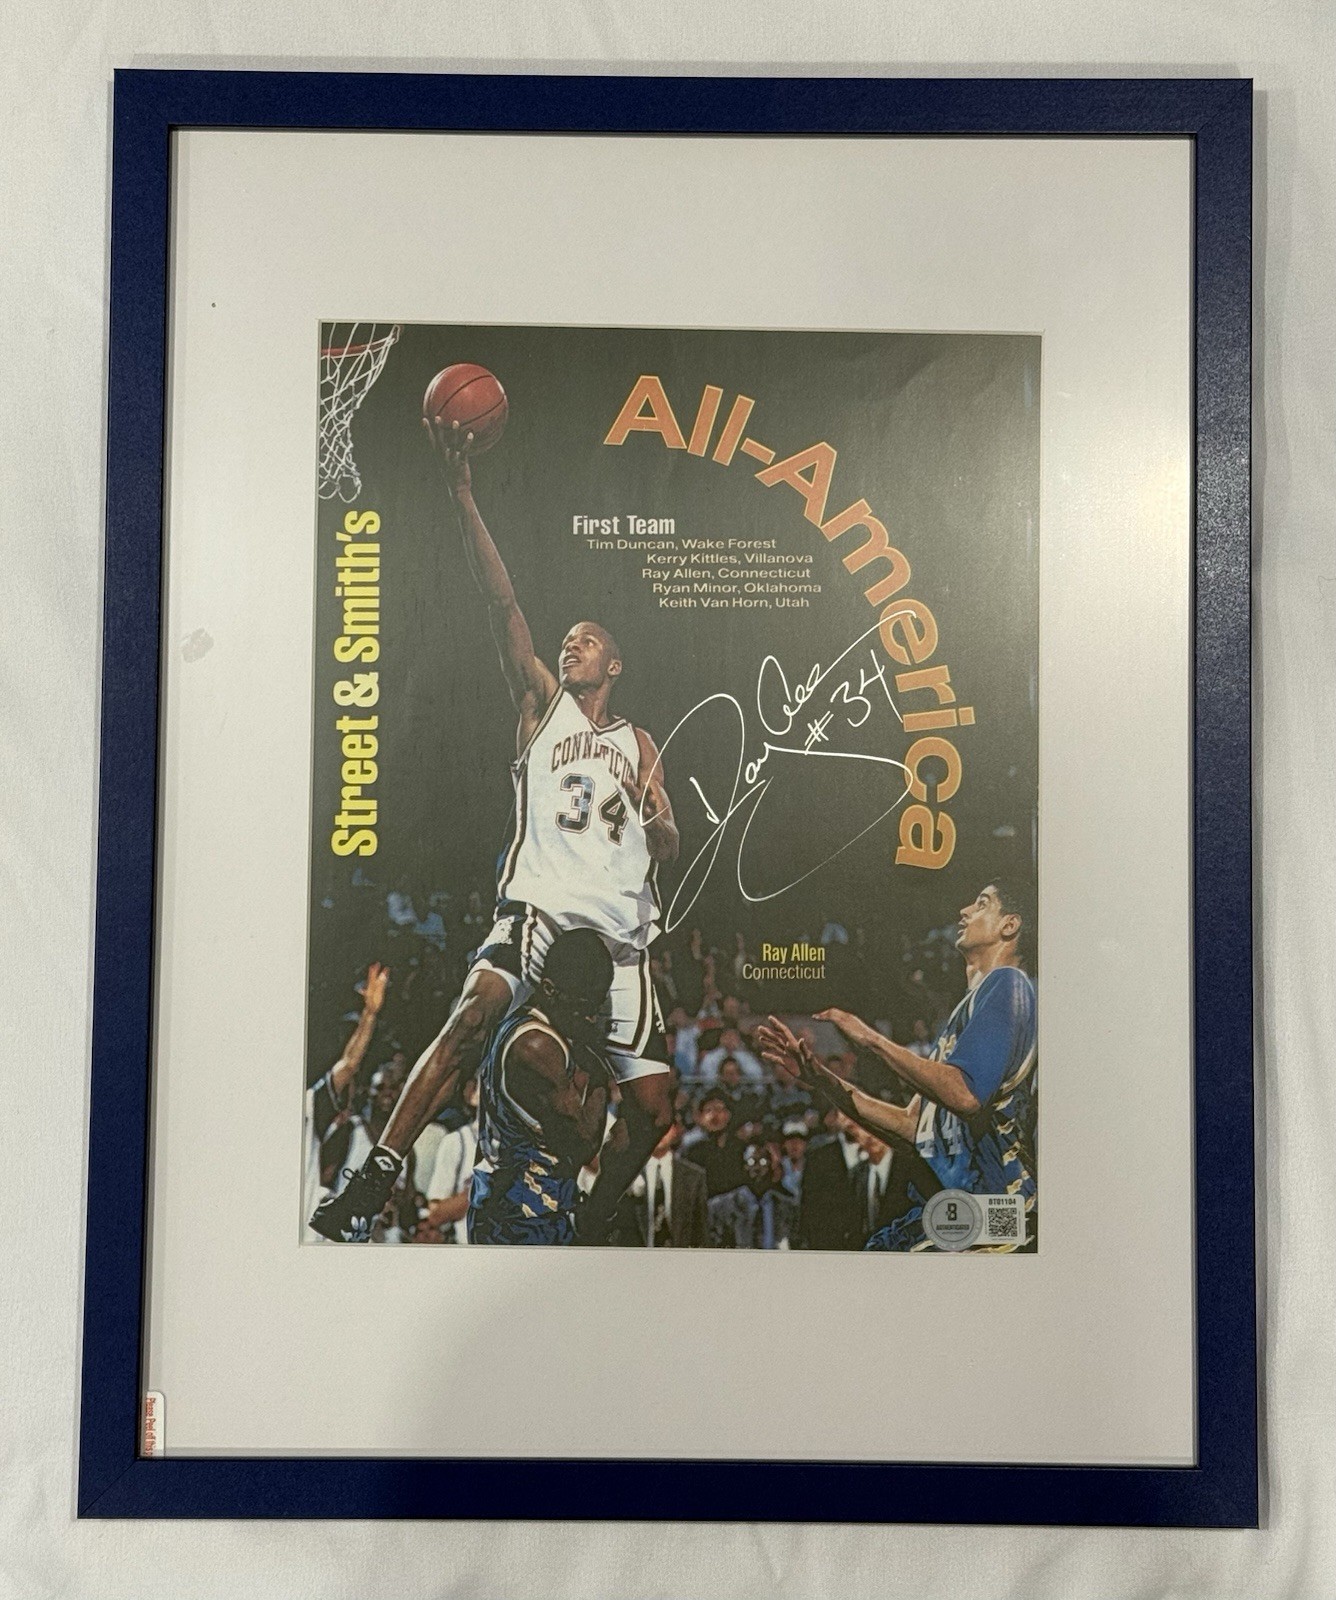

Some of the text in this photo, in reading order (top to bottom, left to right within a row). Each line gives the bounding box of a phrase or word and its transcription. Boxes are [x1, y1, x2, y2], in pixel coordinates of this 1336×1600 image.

[572, 515, 675, 535] First Team
[587, 539, 776, 551] Tim Duncan, Wake Forest
[647, 553, 813, 566] Kerry Kittles, Villanova
[642, 568, 811, 581] Ray Allen, Connecticut
[653, 583, 822, 595] Ryan Minor, Oklahoma
[659, 597, 809, 609] Keith Van Horn, Utah
[603, 375, 976, 870] All-America
[330, 510, 381, 857] Street & Smith's
[555, 772, 630, 847] 34
[762, 943, 826, 964] Ray Allen
[742, 963, 826, 980] Connecticut
